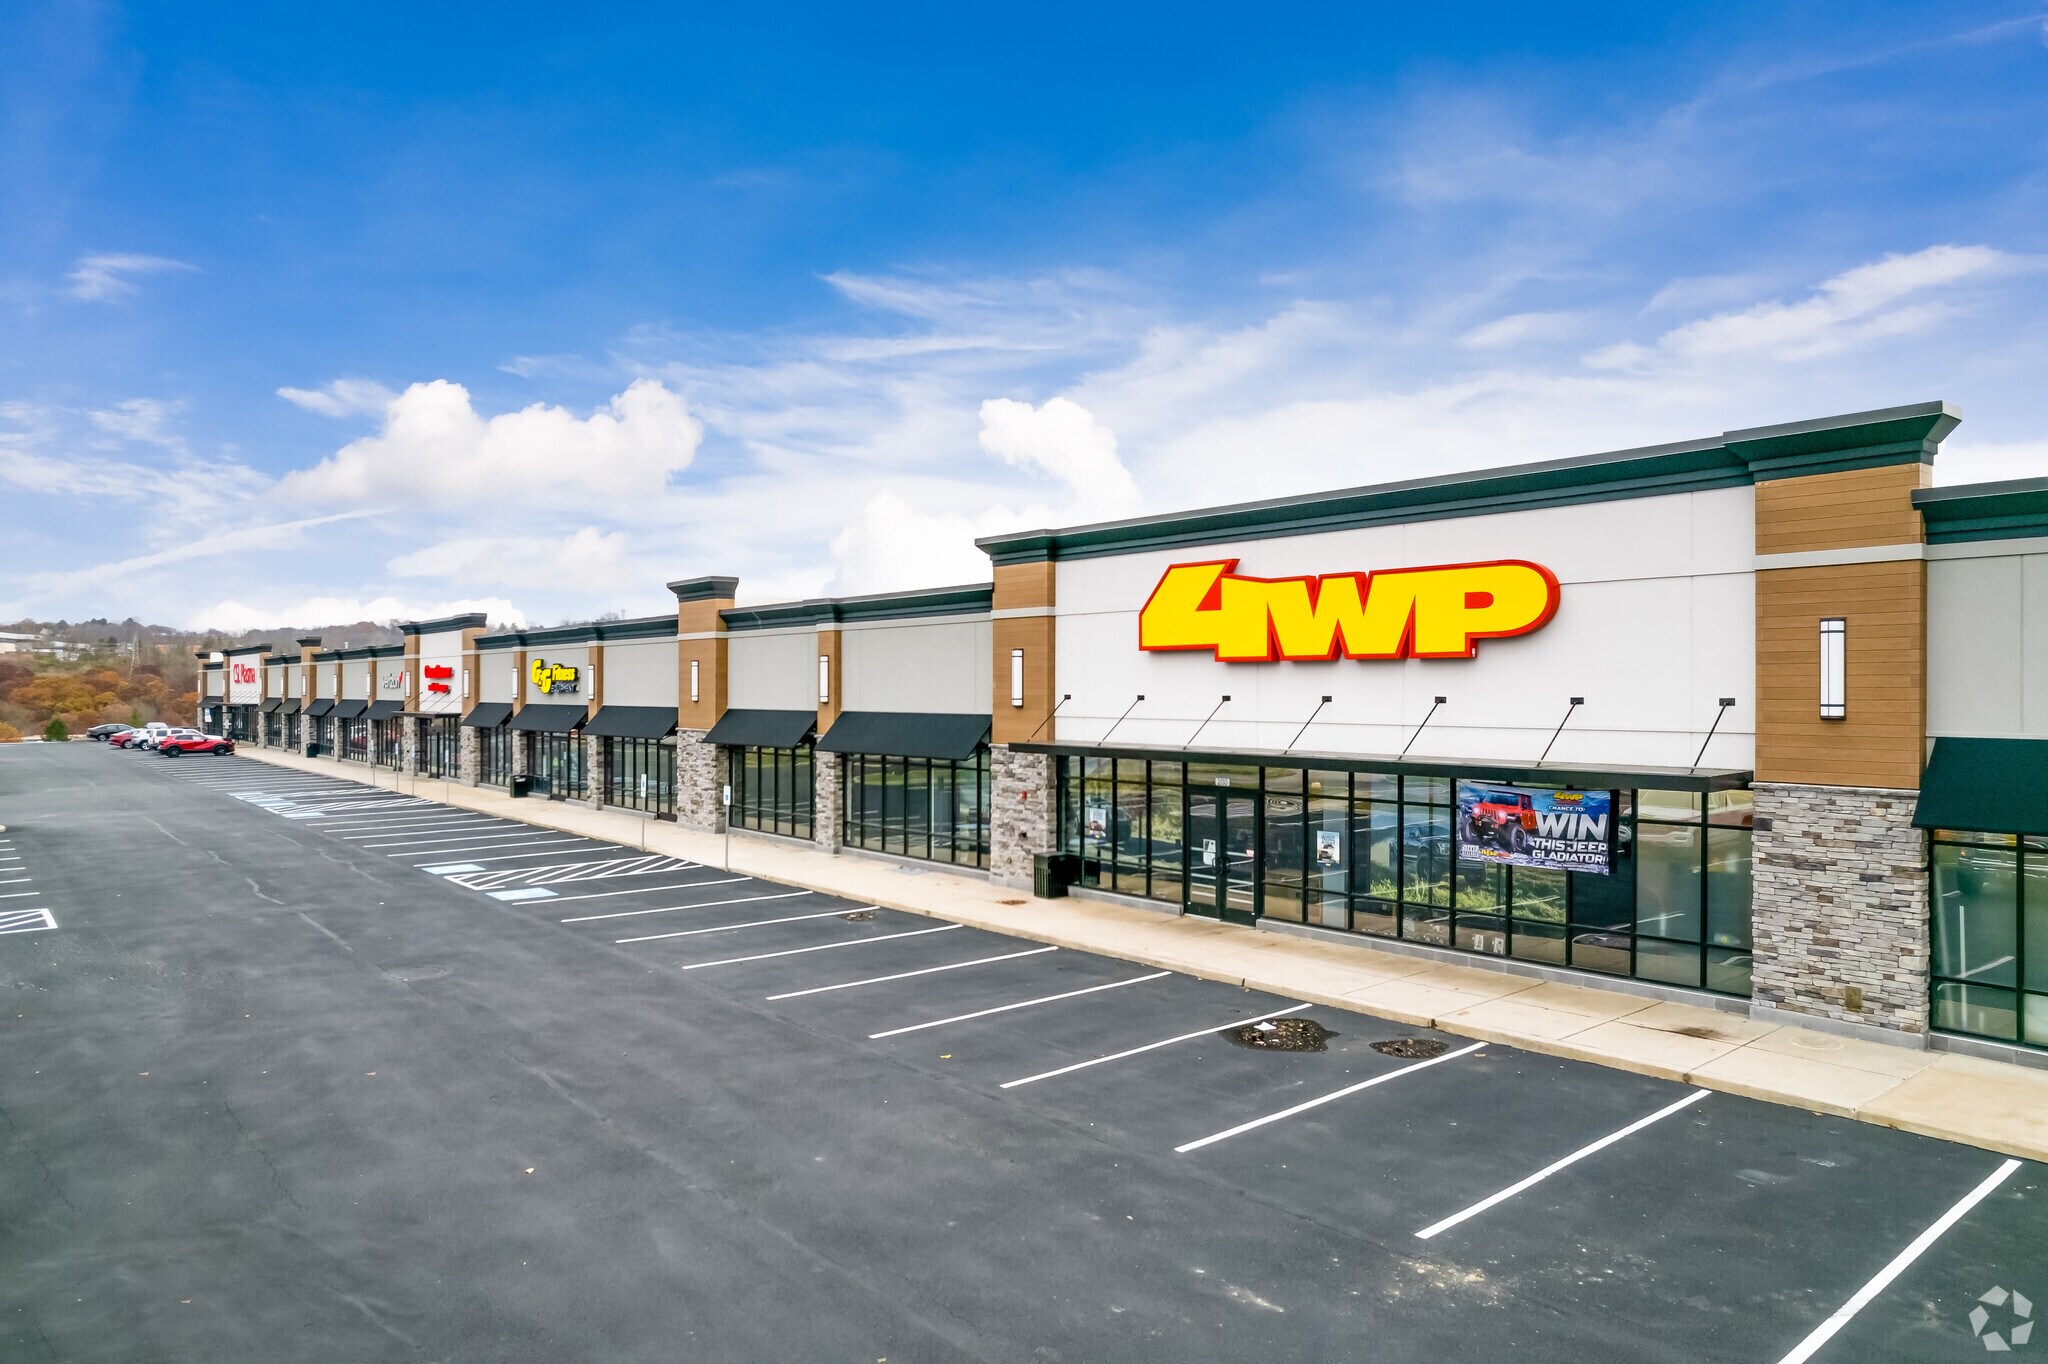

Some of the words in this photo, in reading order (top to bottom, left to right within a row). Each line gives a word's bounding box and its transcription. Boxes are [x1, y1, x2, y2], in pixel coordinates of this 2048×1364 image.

[1139, 559, 1560, 662] 4WP
[552, 663, 576, 681] Fitness
[1553, 791, 1584, 801] 4WP
[1535, 810, 1607, 840] WIN
[1534, 837, 1566, 852] THIS
[1566, 838, 1607, 854] JEEP
[1532, 850, 1606, 864] GLADIATOR!
